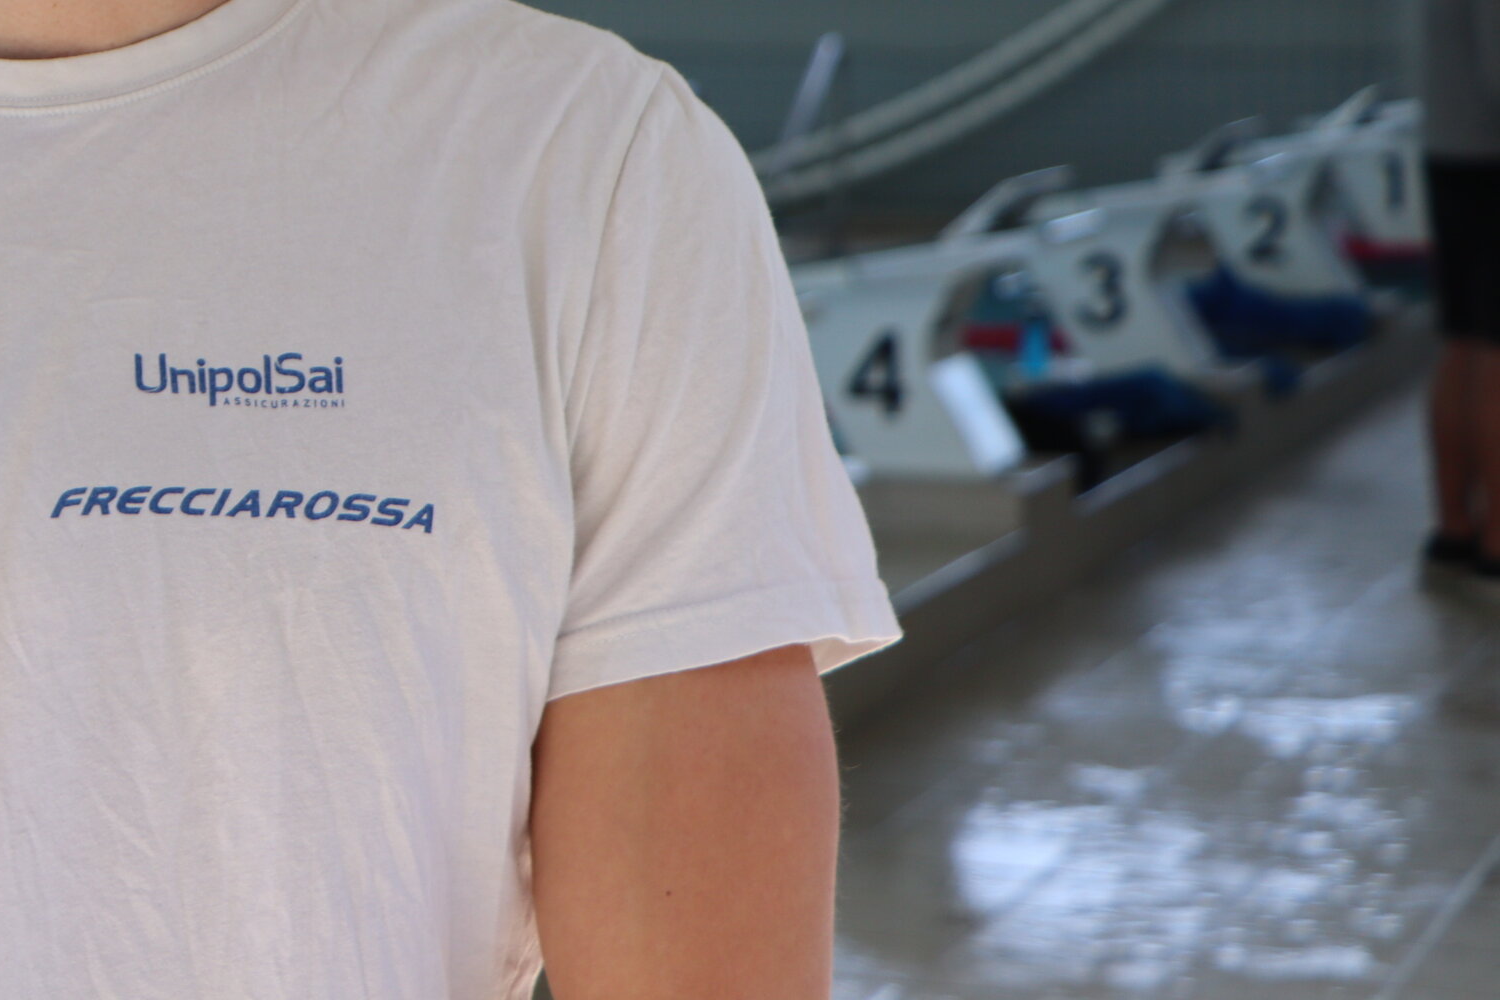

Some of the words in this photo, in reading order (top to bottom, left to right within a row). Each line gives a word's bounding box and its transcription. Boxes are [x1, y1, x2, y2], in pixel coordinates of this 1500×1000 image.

[1245, 197, 1288, 264] 2
[1075, 251, 1129, 329] 3
[134, 352, 344, 407] UnipolSai
[850, 327, 907, 416] 4
[223, 397, 346, 409] ASSICURAZIONI
[50, 486, 436, 534] FRECCIAROSSA
